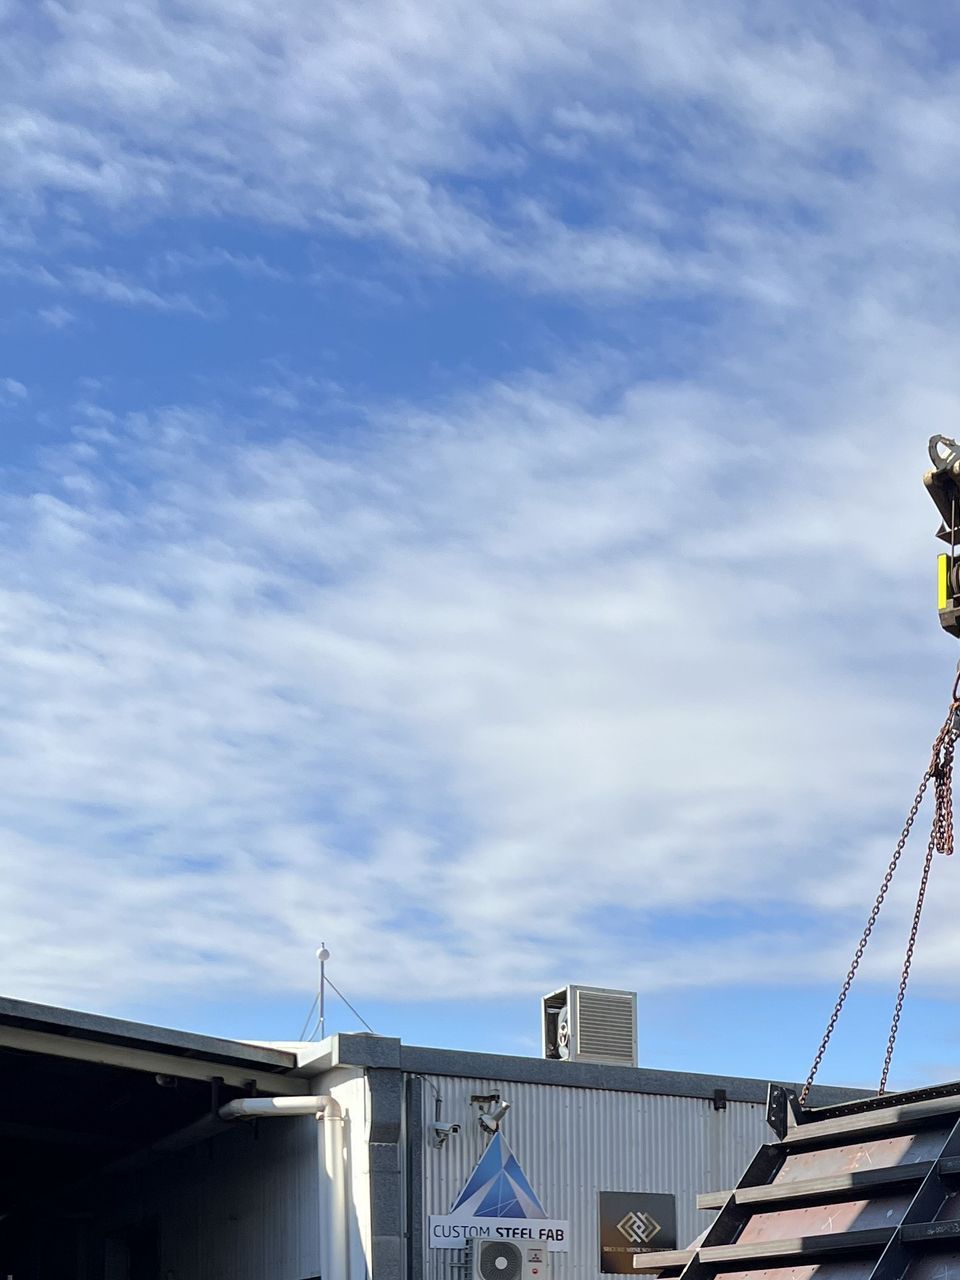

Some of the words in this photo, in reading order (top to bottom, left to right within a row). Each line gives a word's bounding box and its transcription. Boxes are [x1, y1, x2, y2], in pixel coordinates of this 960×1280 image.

[433, 1224, 490, 1239] CUSTOM
[495, 1227, 535, 1239] STEEL
[539, 1228, 565, 1241] FAB
